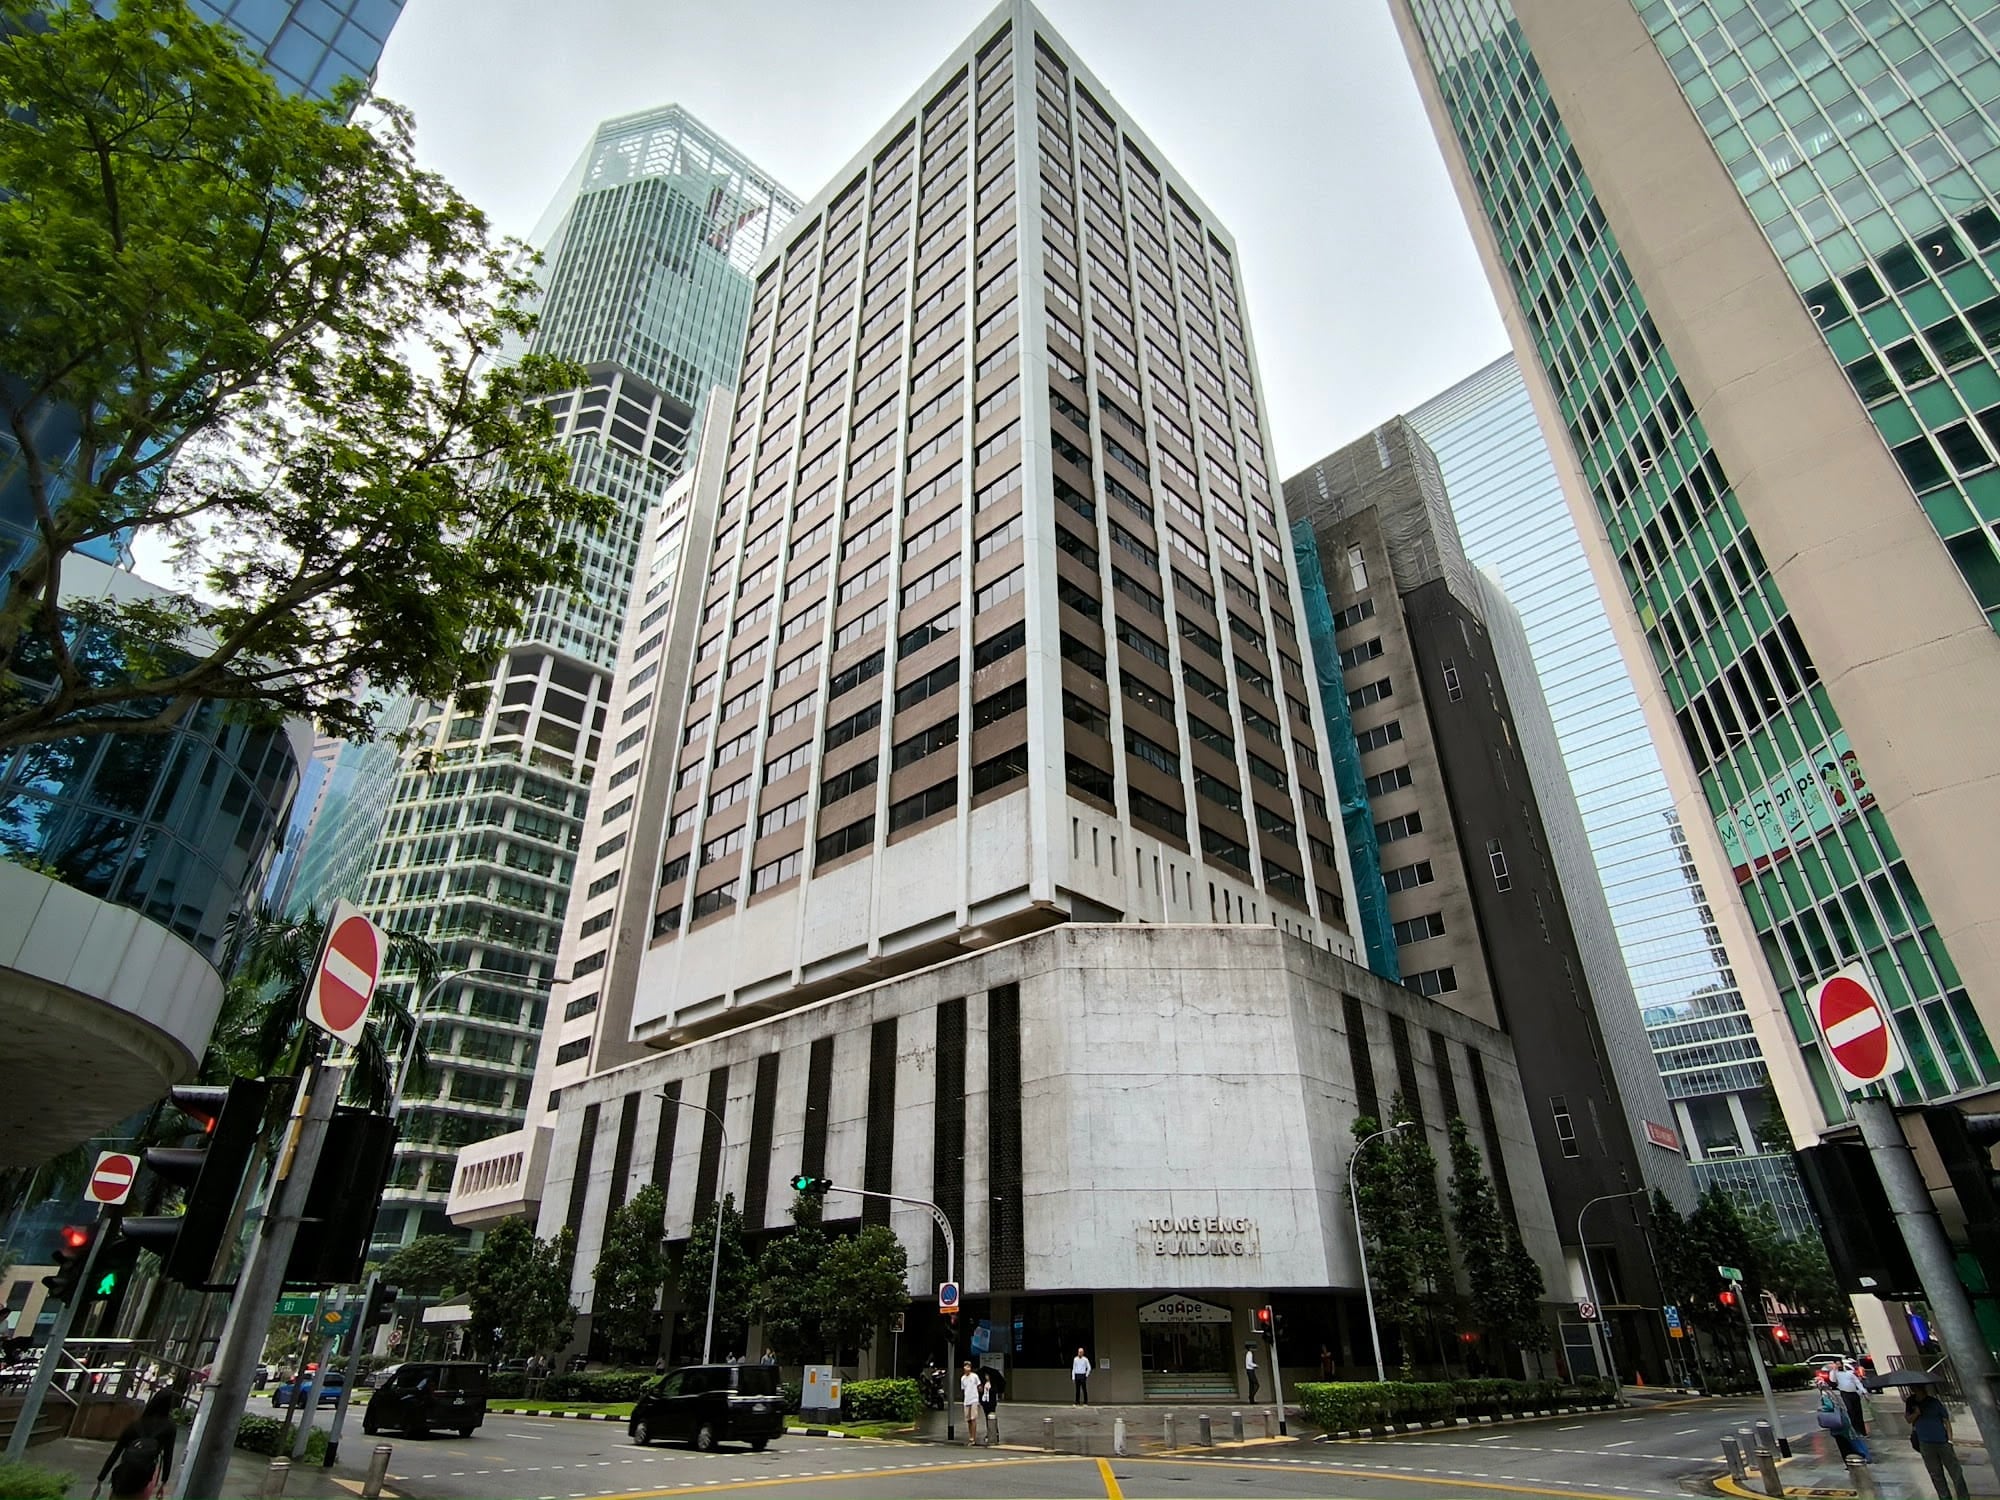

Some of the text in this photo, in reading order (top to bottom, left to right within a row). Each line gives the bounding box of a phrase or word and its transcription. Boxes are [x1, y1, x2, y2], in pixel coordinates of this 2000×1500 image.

[1149, 1216, 1245, 1233] TONG ENG
[1155, 1239, 1243, 1256] BUILDING
